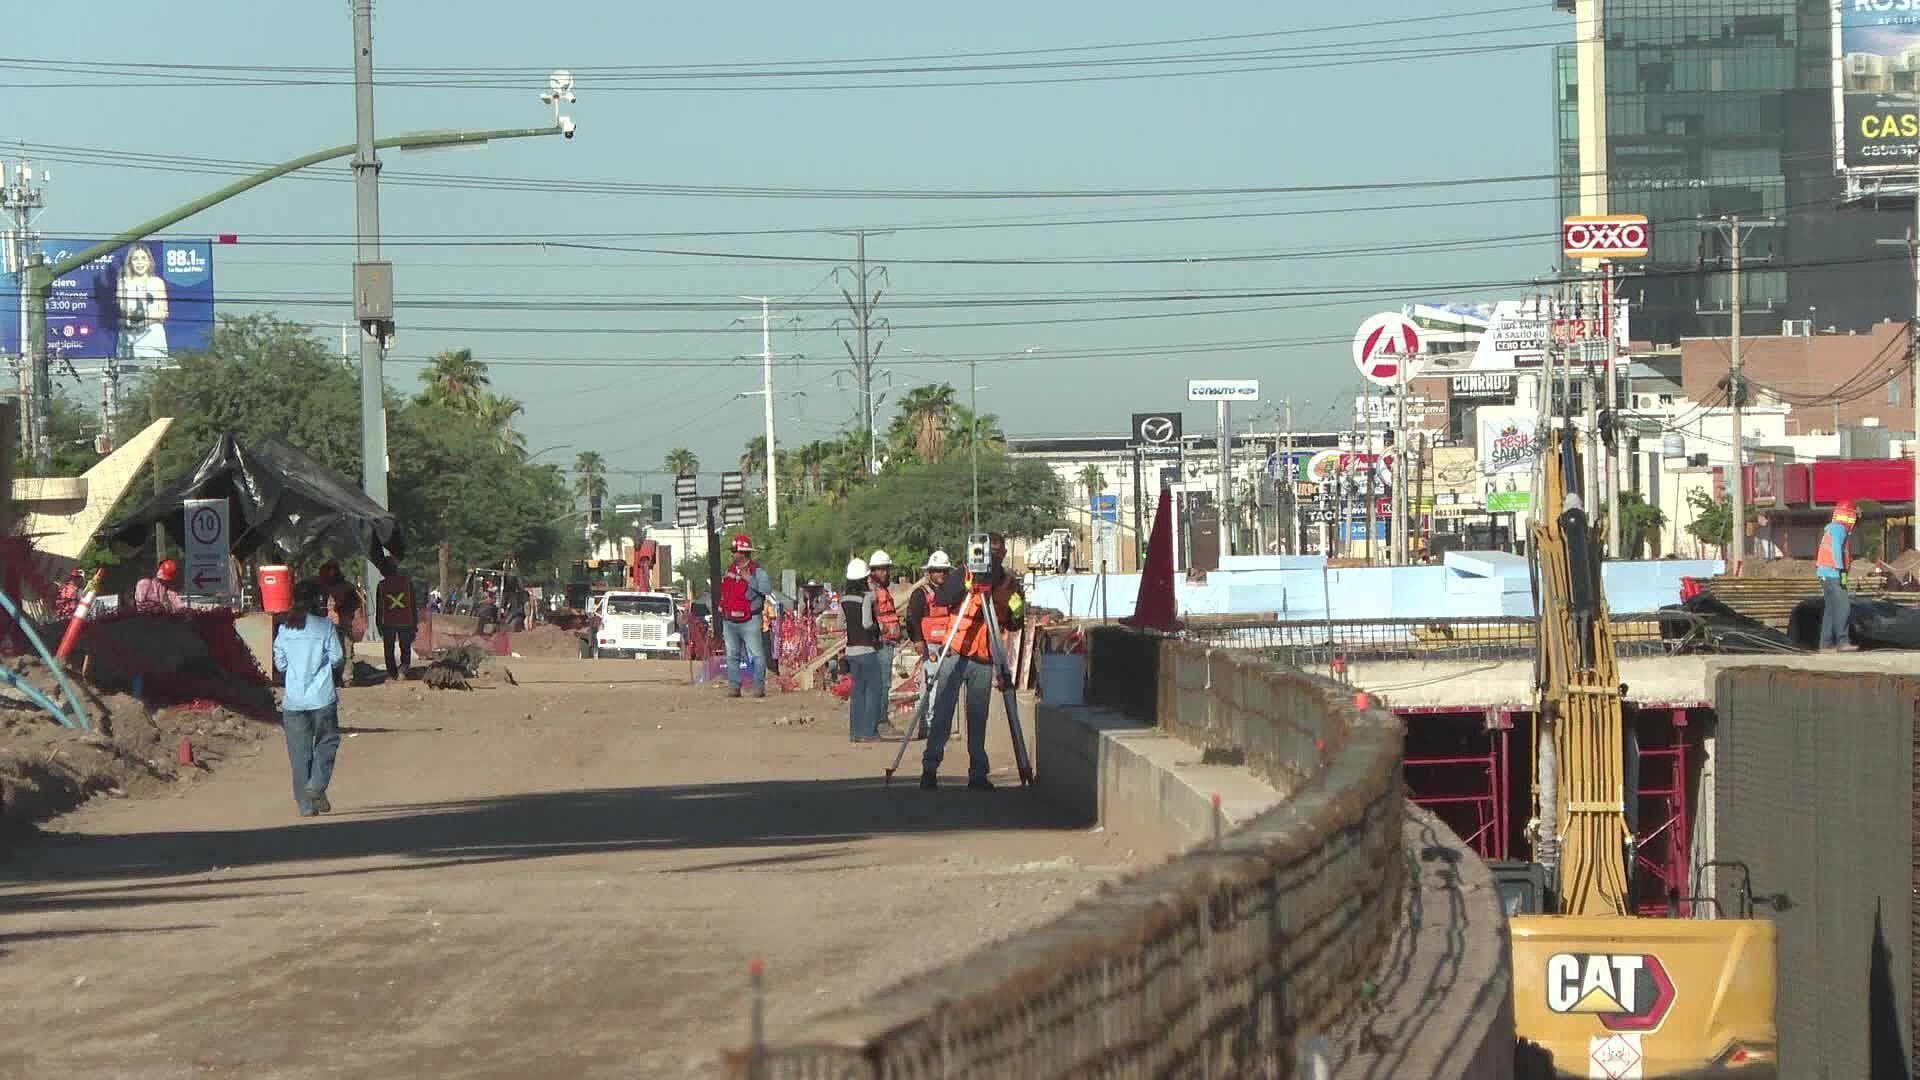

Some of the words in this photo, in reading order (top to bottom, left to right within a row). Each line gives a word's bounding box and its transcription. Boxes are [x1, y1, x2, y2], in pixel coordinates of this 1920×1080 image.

[1567, 222, 1645, 249] OXXO
[166, 249, 196, 266] 88.1
[51, 300, 70, 310] 3:00
[71, 302, 88, 312] pm
[198, 514, 215, 531] 10
[1548, 953, 1643, 1014] CAT
